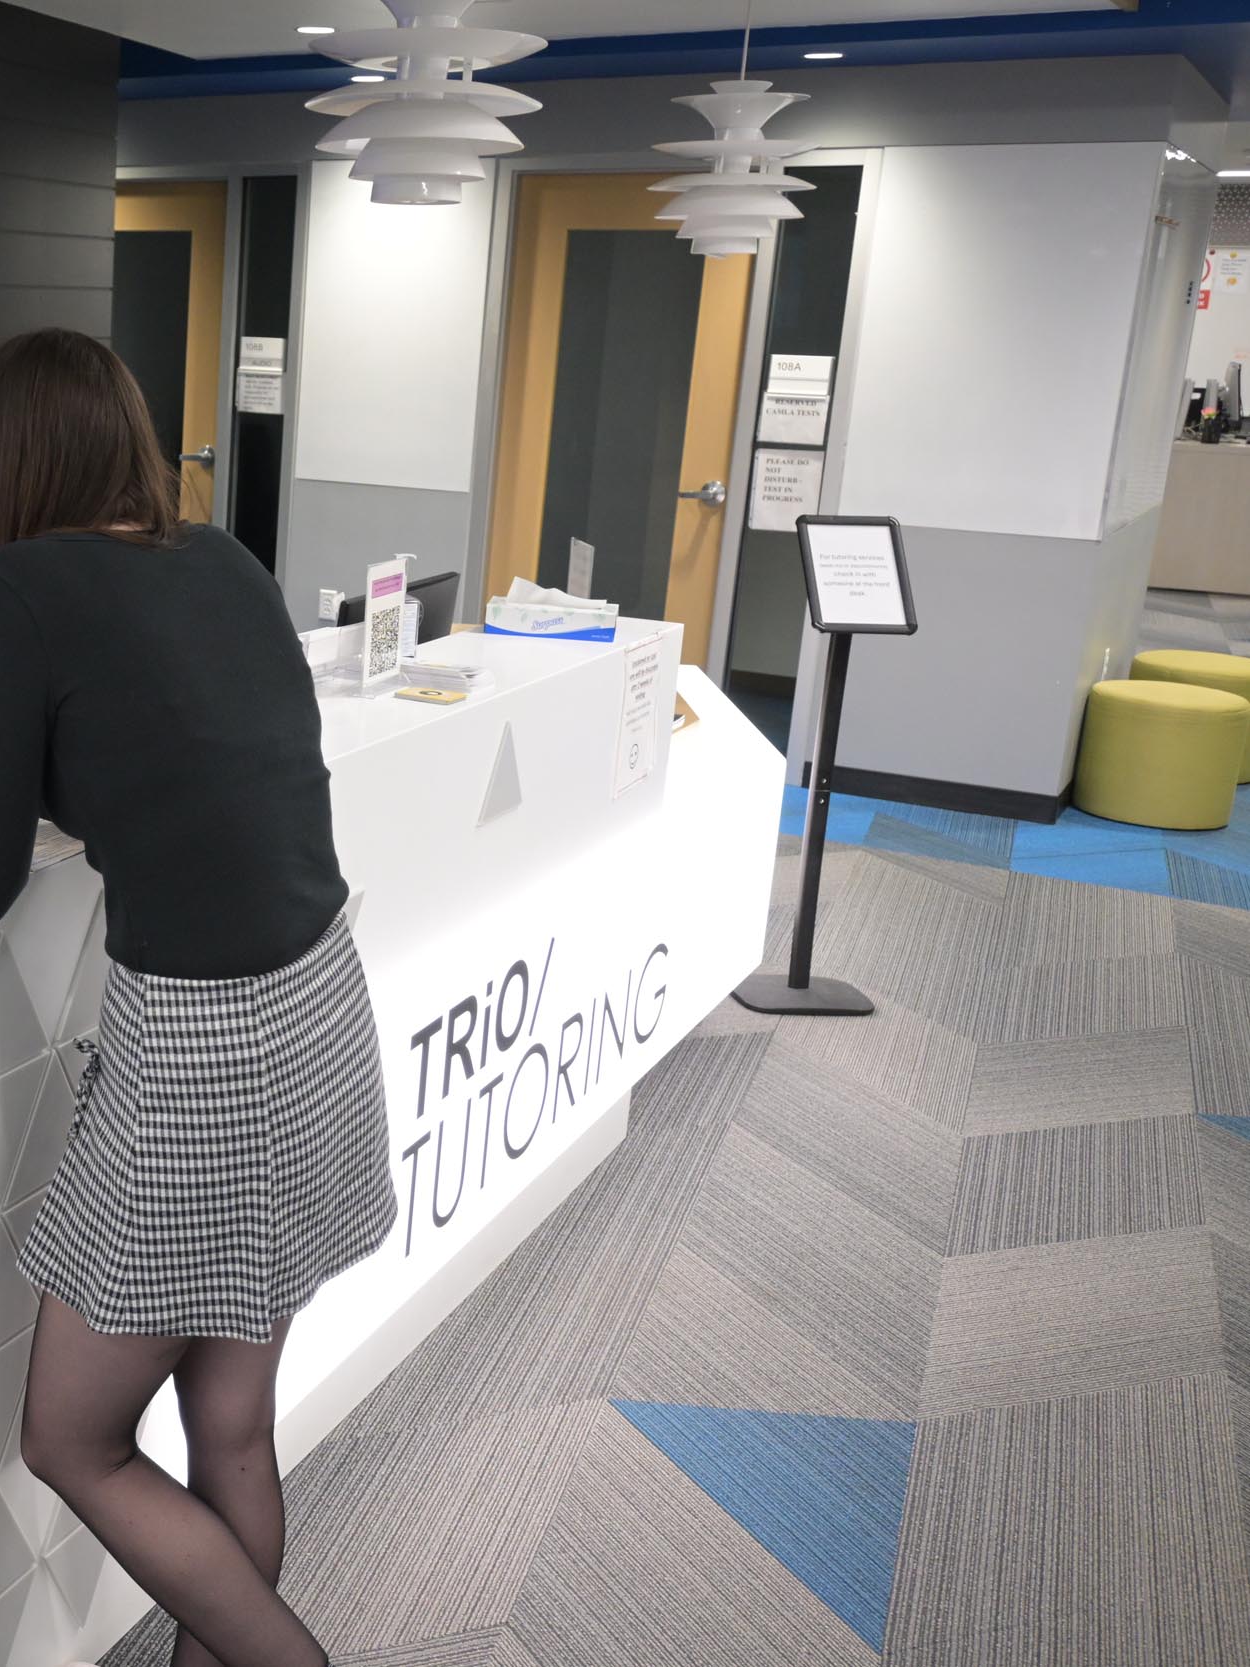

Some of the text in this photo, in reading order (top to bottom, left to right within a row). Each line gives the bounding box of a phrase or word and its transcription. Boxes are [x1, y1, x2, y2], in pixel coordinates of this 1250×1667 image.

[777, 361, 801, 371] 108A
[797, 408, 820, 417] TESTS
[401, 942, 669, 1258] TUTORING
